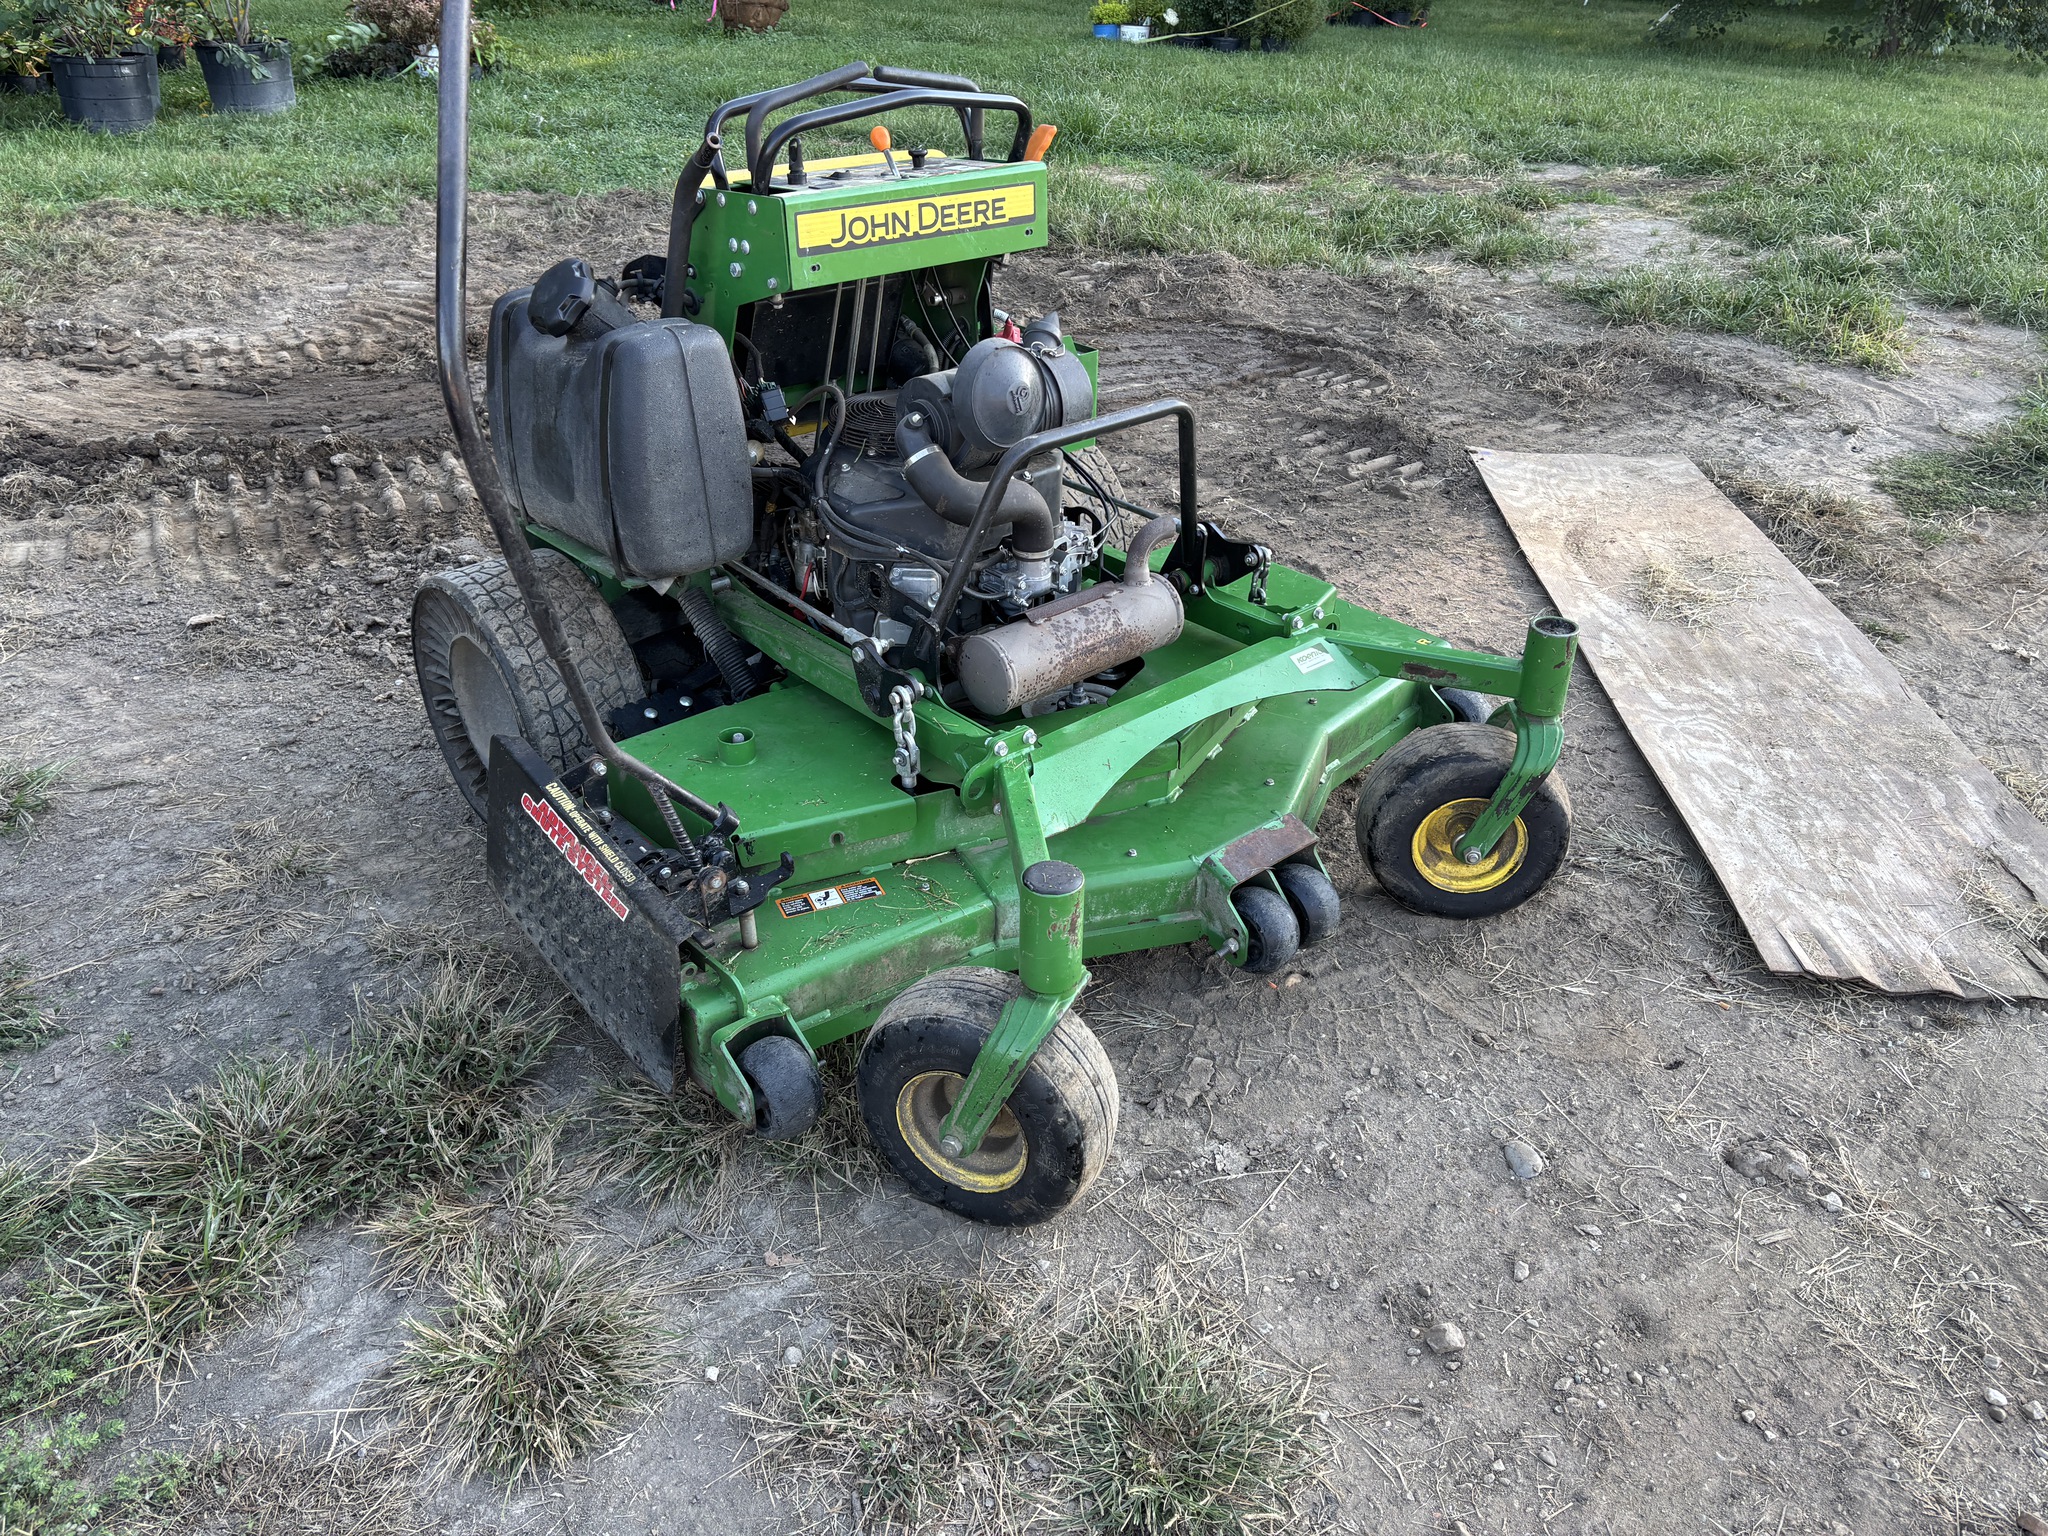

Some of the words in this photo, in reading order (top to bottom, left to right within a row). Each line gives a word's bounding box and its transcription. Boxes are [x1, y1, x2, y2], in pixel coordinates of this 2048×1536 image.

[831, 210, 910, 244] JOHN
[918, 197, 1006, 231] DEERE
[522, 794, 567, 852] CHUTE
[565, 843, 628, 920] SYSTEM
[545, 782, 576, 814] CAUTION:
[568, 809, 593, 834] OPERATE
[588, 829, 605, 847] WITH
[598, 843, 620, 864] SHIELD
[614, 860, 637, 883] CLOSED
